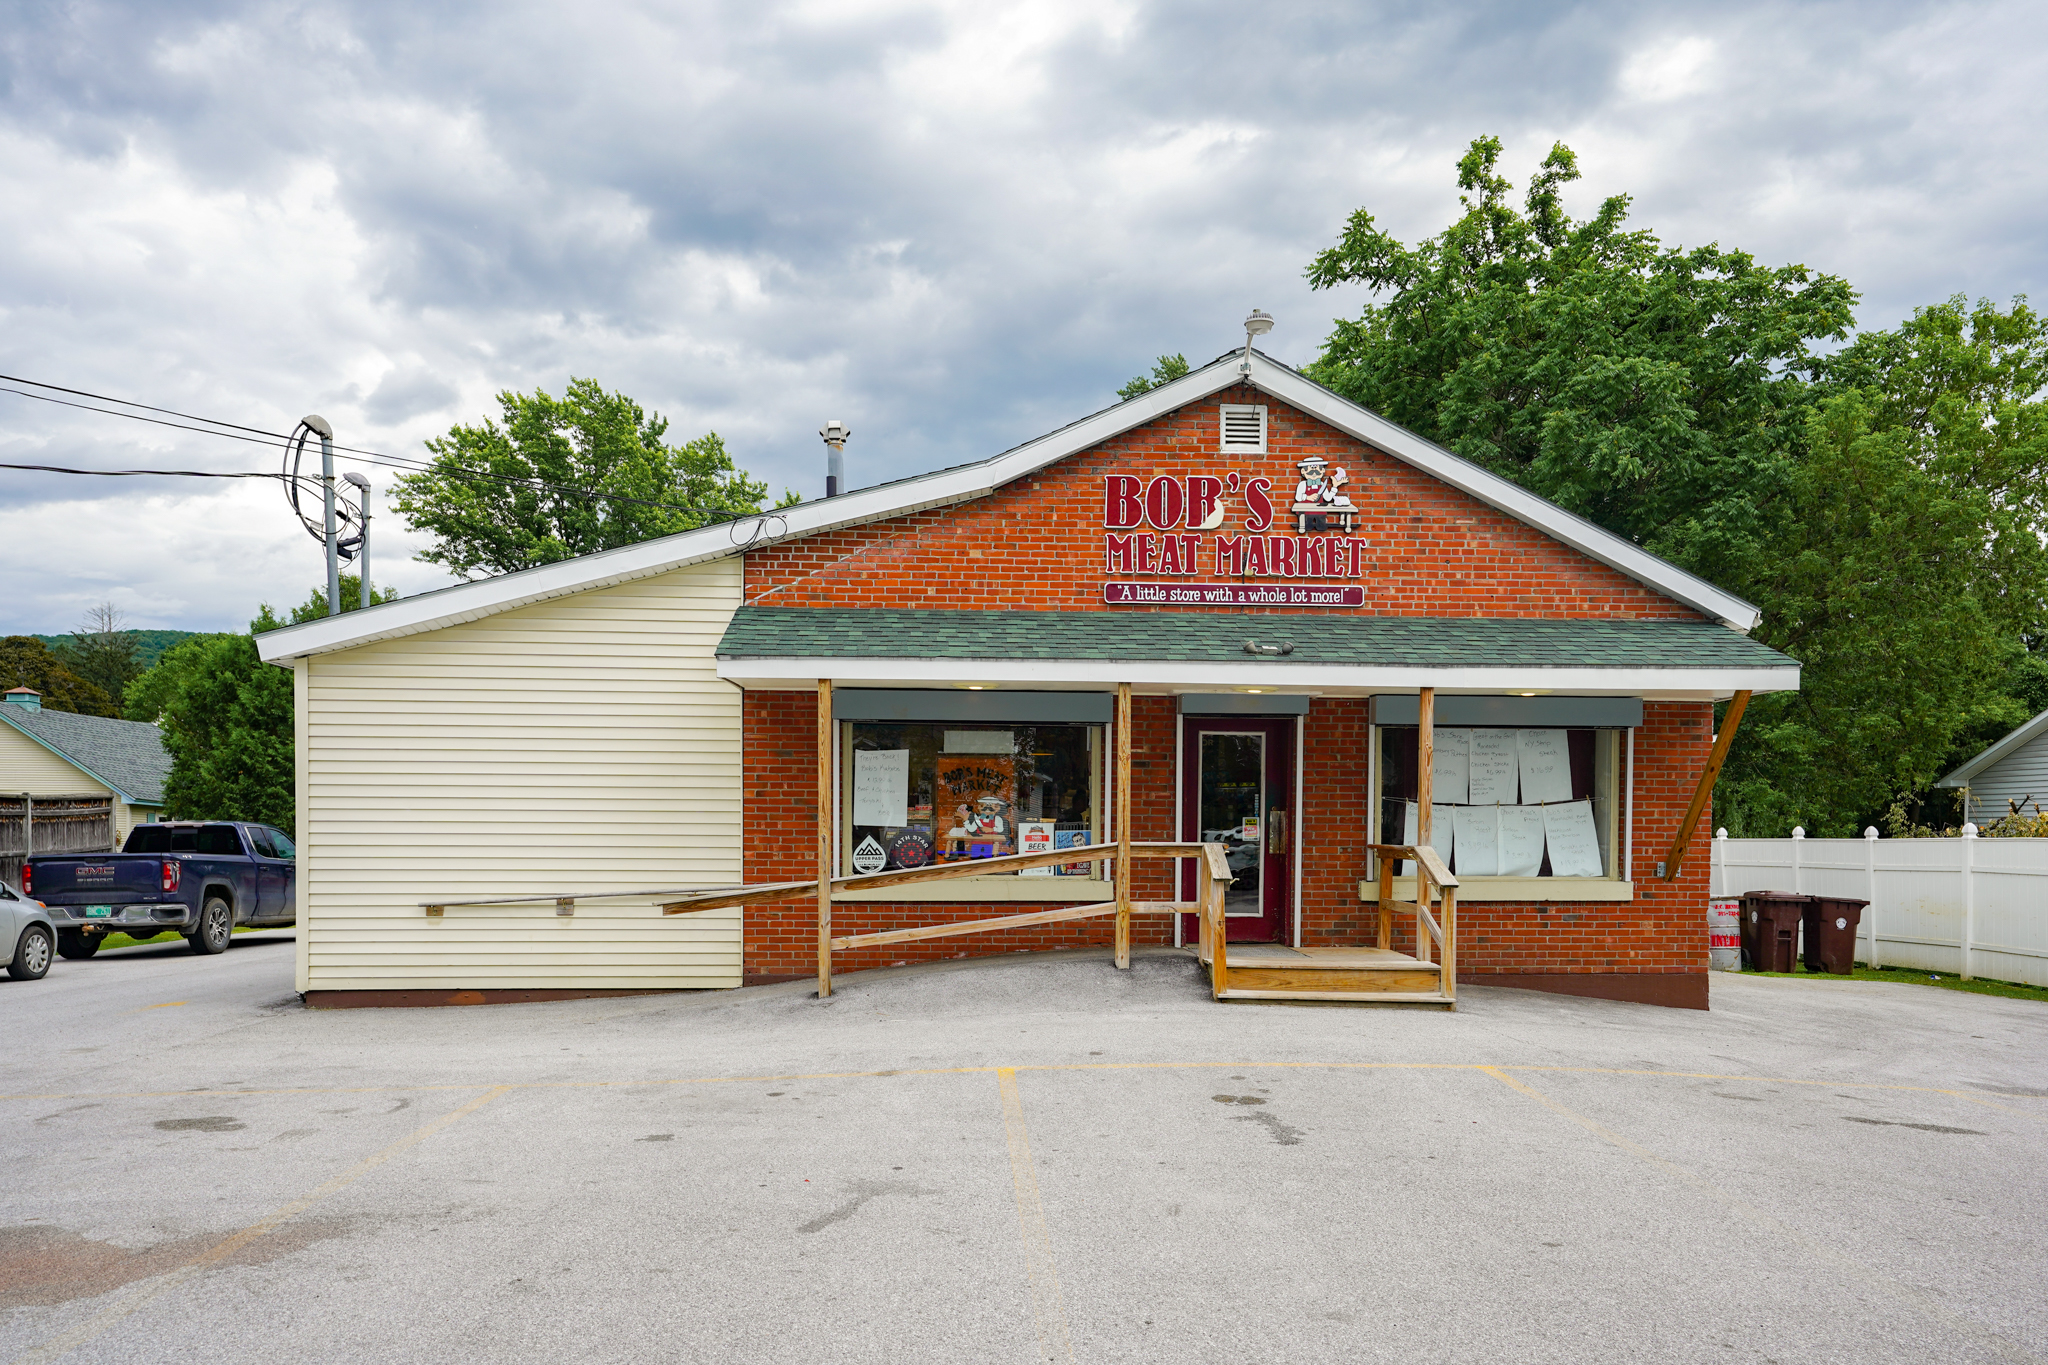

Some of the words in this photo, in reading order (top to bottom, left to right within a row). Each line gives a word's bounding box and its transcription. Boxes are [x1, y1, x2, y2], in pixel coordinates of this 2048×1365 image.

[1104, 472, 1274, 533] BOB'S
[1105, 532, 1202, 575] MEAT
[1214, 535, 1367, 578] MARKET
[1136, 585, 1167, 601] little
[1170, 588, 1200, 602] store
[1203, 587, 1234, 602] with
[1238, 590, 1246, 602] a
[1248, 587, 1287, 603] whole
[1290, 587, 1308, 603] lot
[942, 766, 973, 784] BOB'S
[976, 767, 1009, 785] MEAT
[951, 779, 1002, 796] MARKET
[895, 834, 911, 848] 14TH
[912, 834, 929, 849] STAR
[1028, 843, 1047, 851] BEER
[76, 866, 115, 876] GMC
